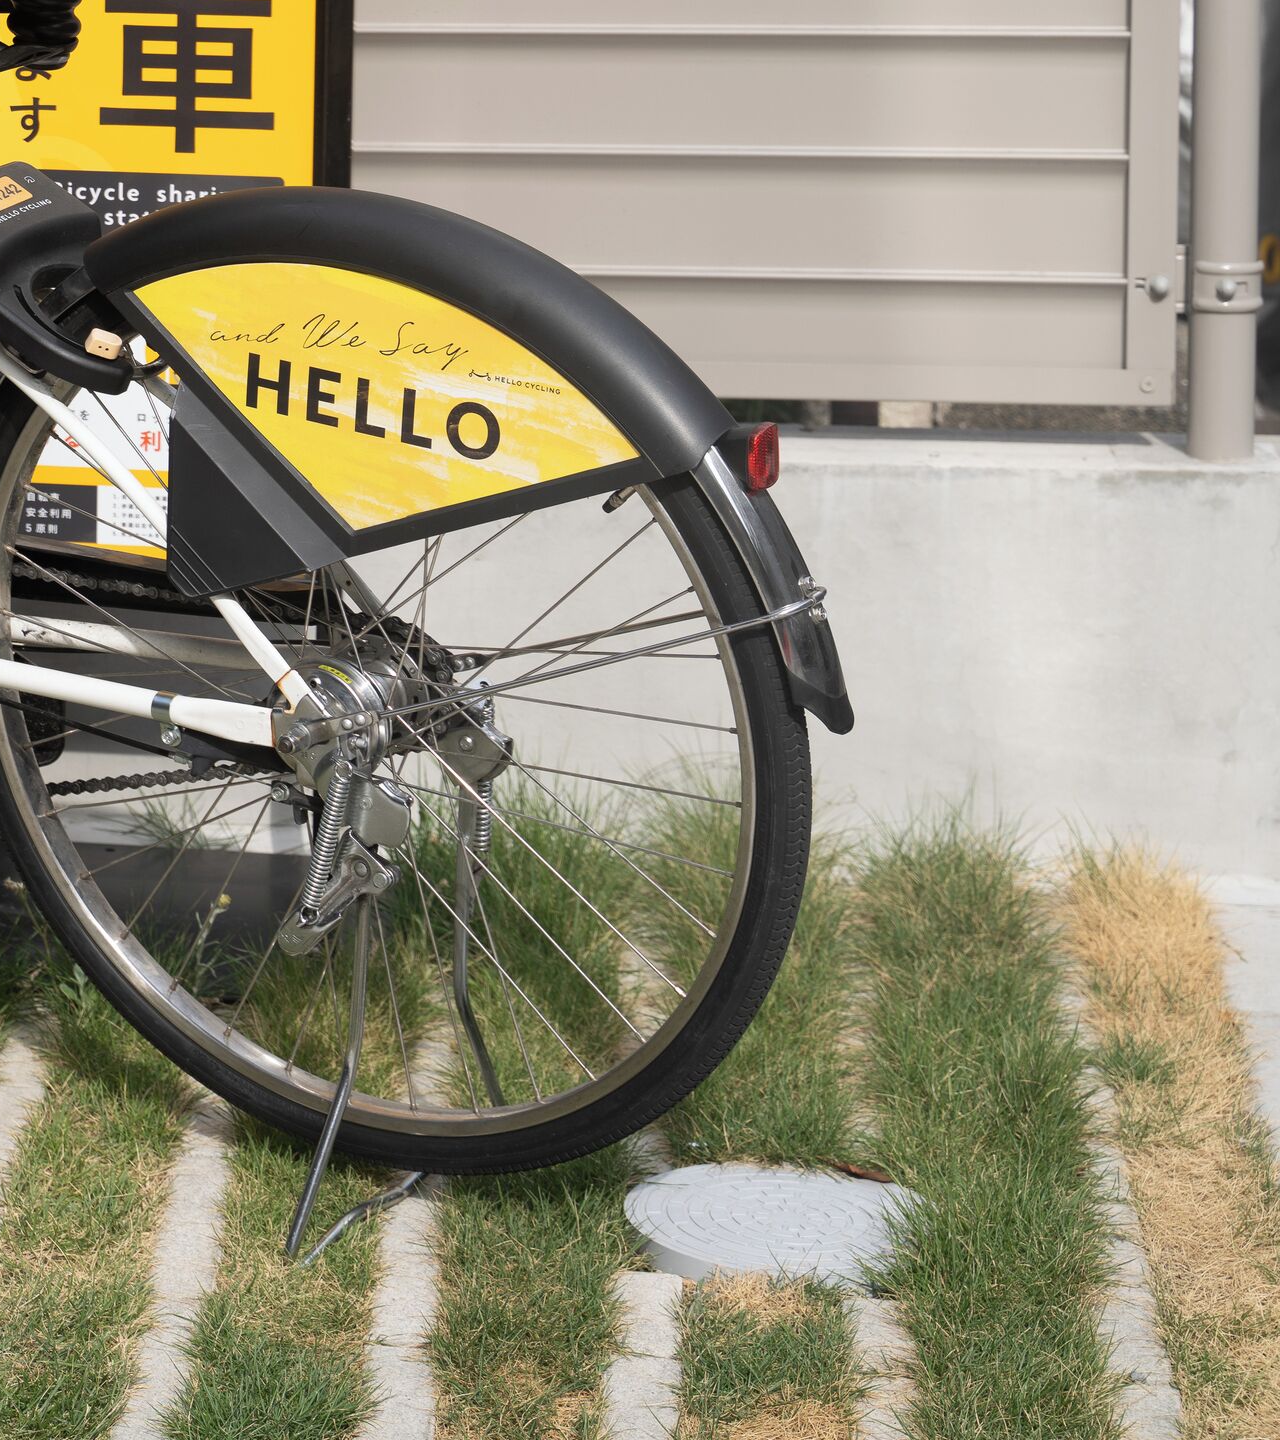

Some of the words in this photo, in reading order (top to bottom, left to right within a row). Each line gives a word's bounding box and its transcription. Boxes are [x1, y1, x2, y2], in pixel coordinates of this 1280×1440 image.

[20, 198, 53, 213] CYCLING
[210, 323, 286, 344] and
[302, 313, 366, 349] We
[379, 321, 469, 371] Say
[494, 375, 522, 388] HELLO
[525, 382, 561, 395] CYCLING
[246, 352, 501, 460] HELLO
[25, 508, 72, 520] 安全利用
